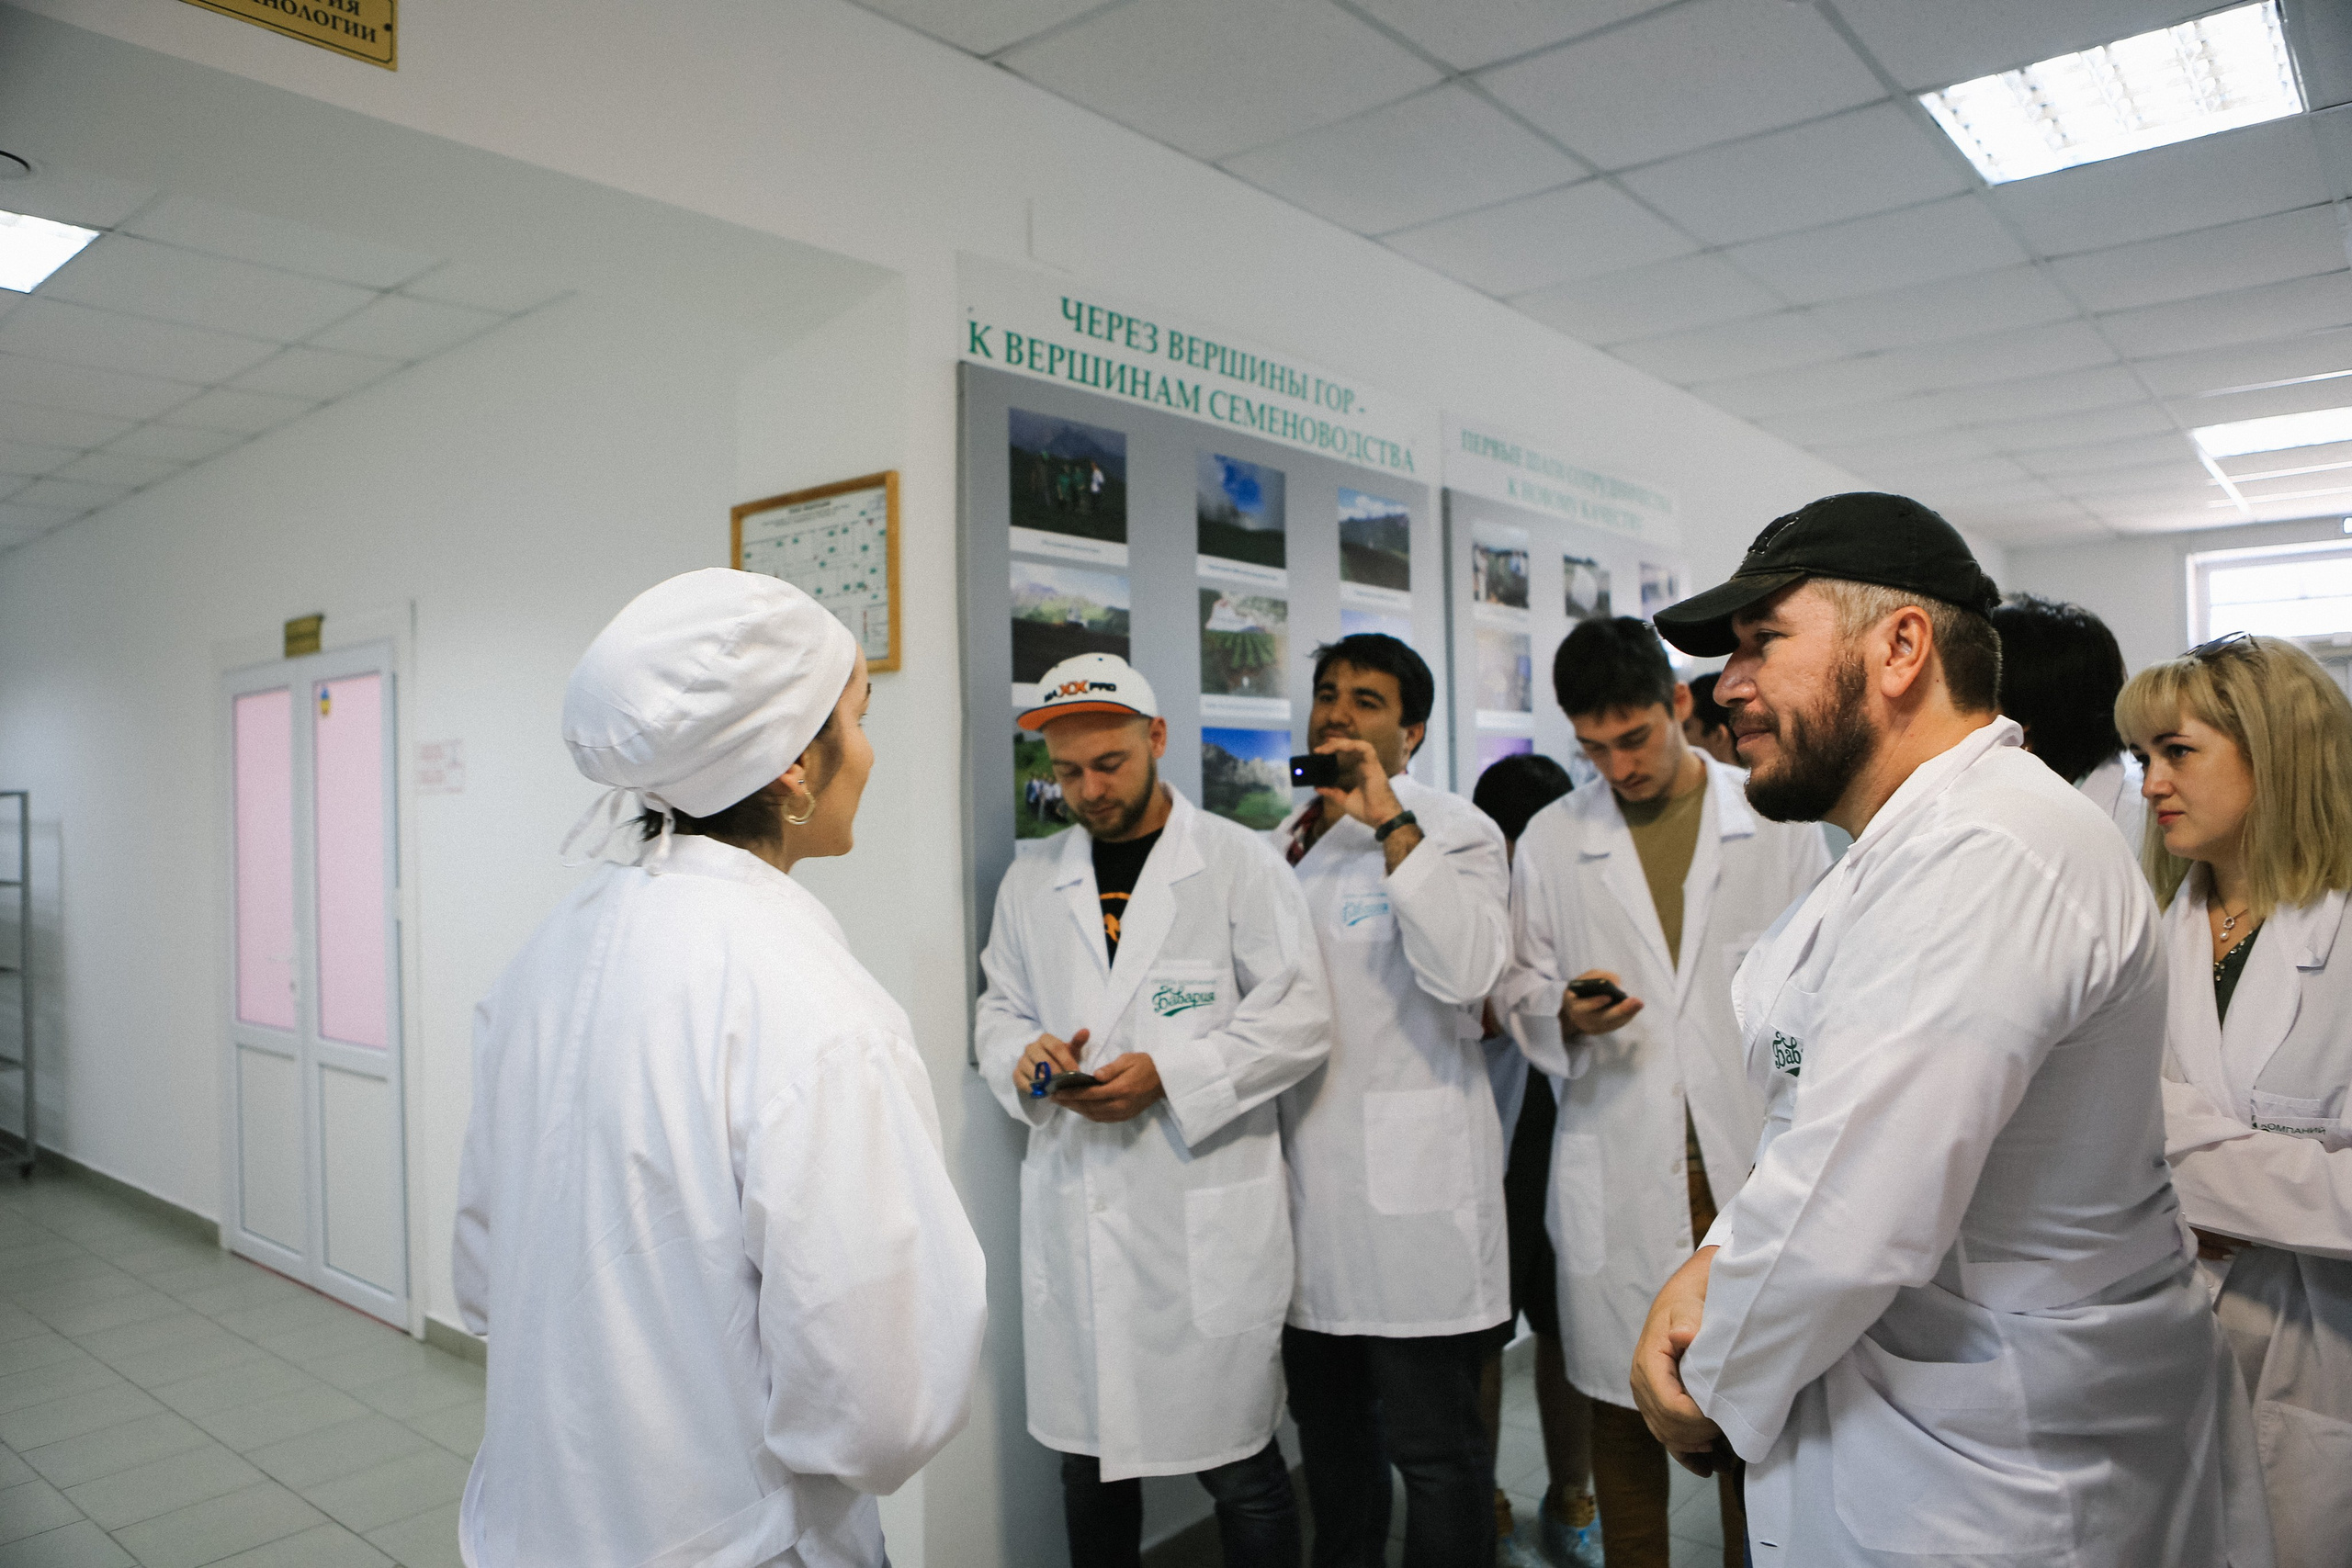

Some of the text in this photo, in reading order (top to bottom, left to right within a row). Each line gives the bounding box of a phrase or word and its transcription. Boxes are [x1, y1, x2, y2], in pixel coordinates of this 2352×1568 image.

[315, 0, 359, 16] ИЯ
[967, 320, 1415, 474] К ВЕРШИНАМ СЕМЕНОВОДСТВА
[1060, 296, 1159, 354] ЧЕРЕЗ
[1168, 329, 1308, 401] ВЕРШИНЫ
[1314, 378, 1355, 415] ГОР
